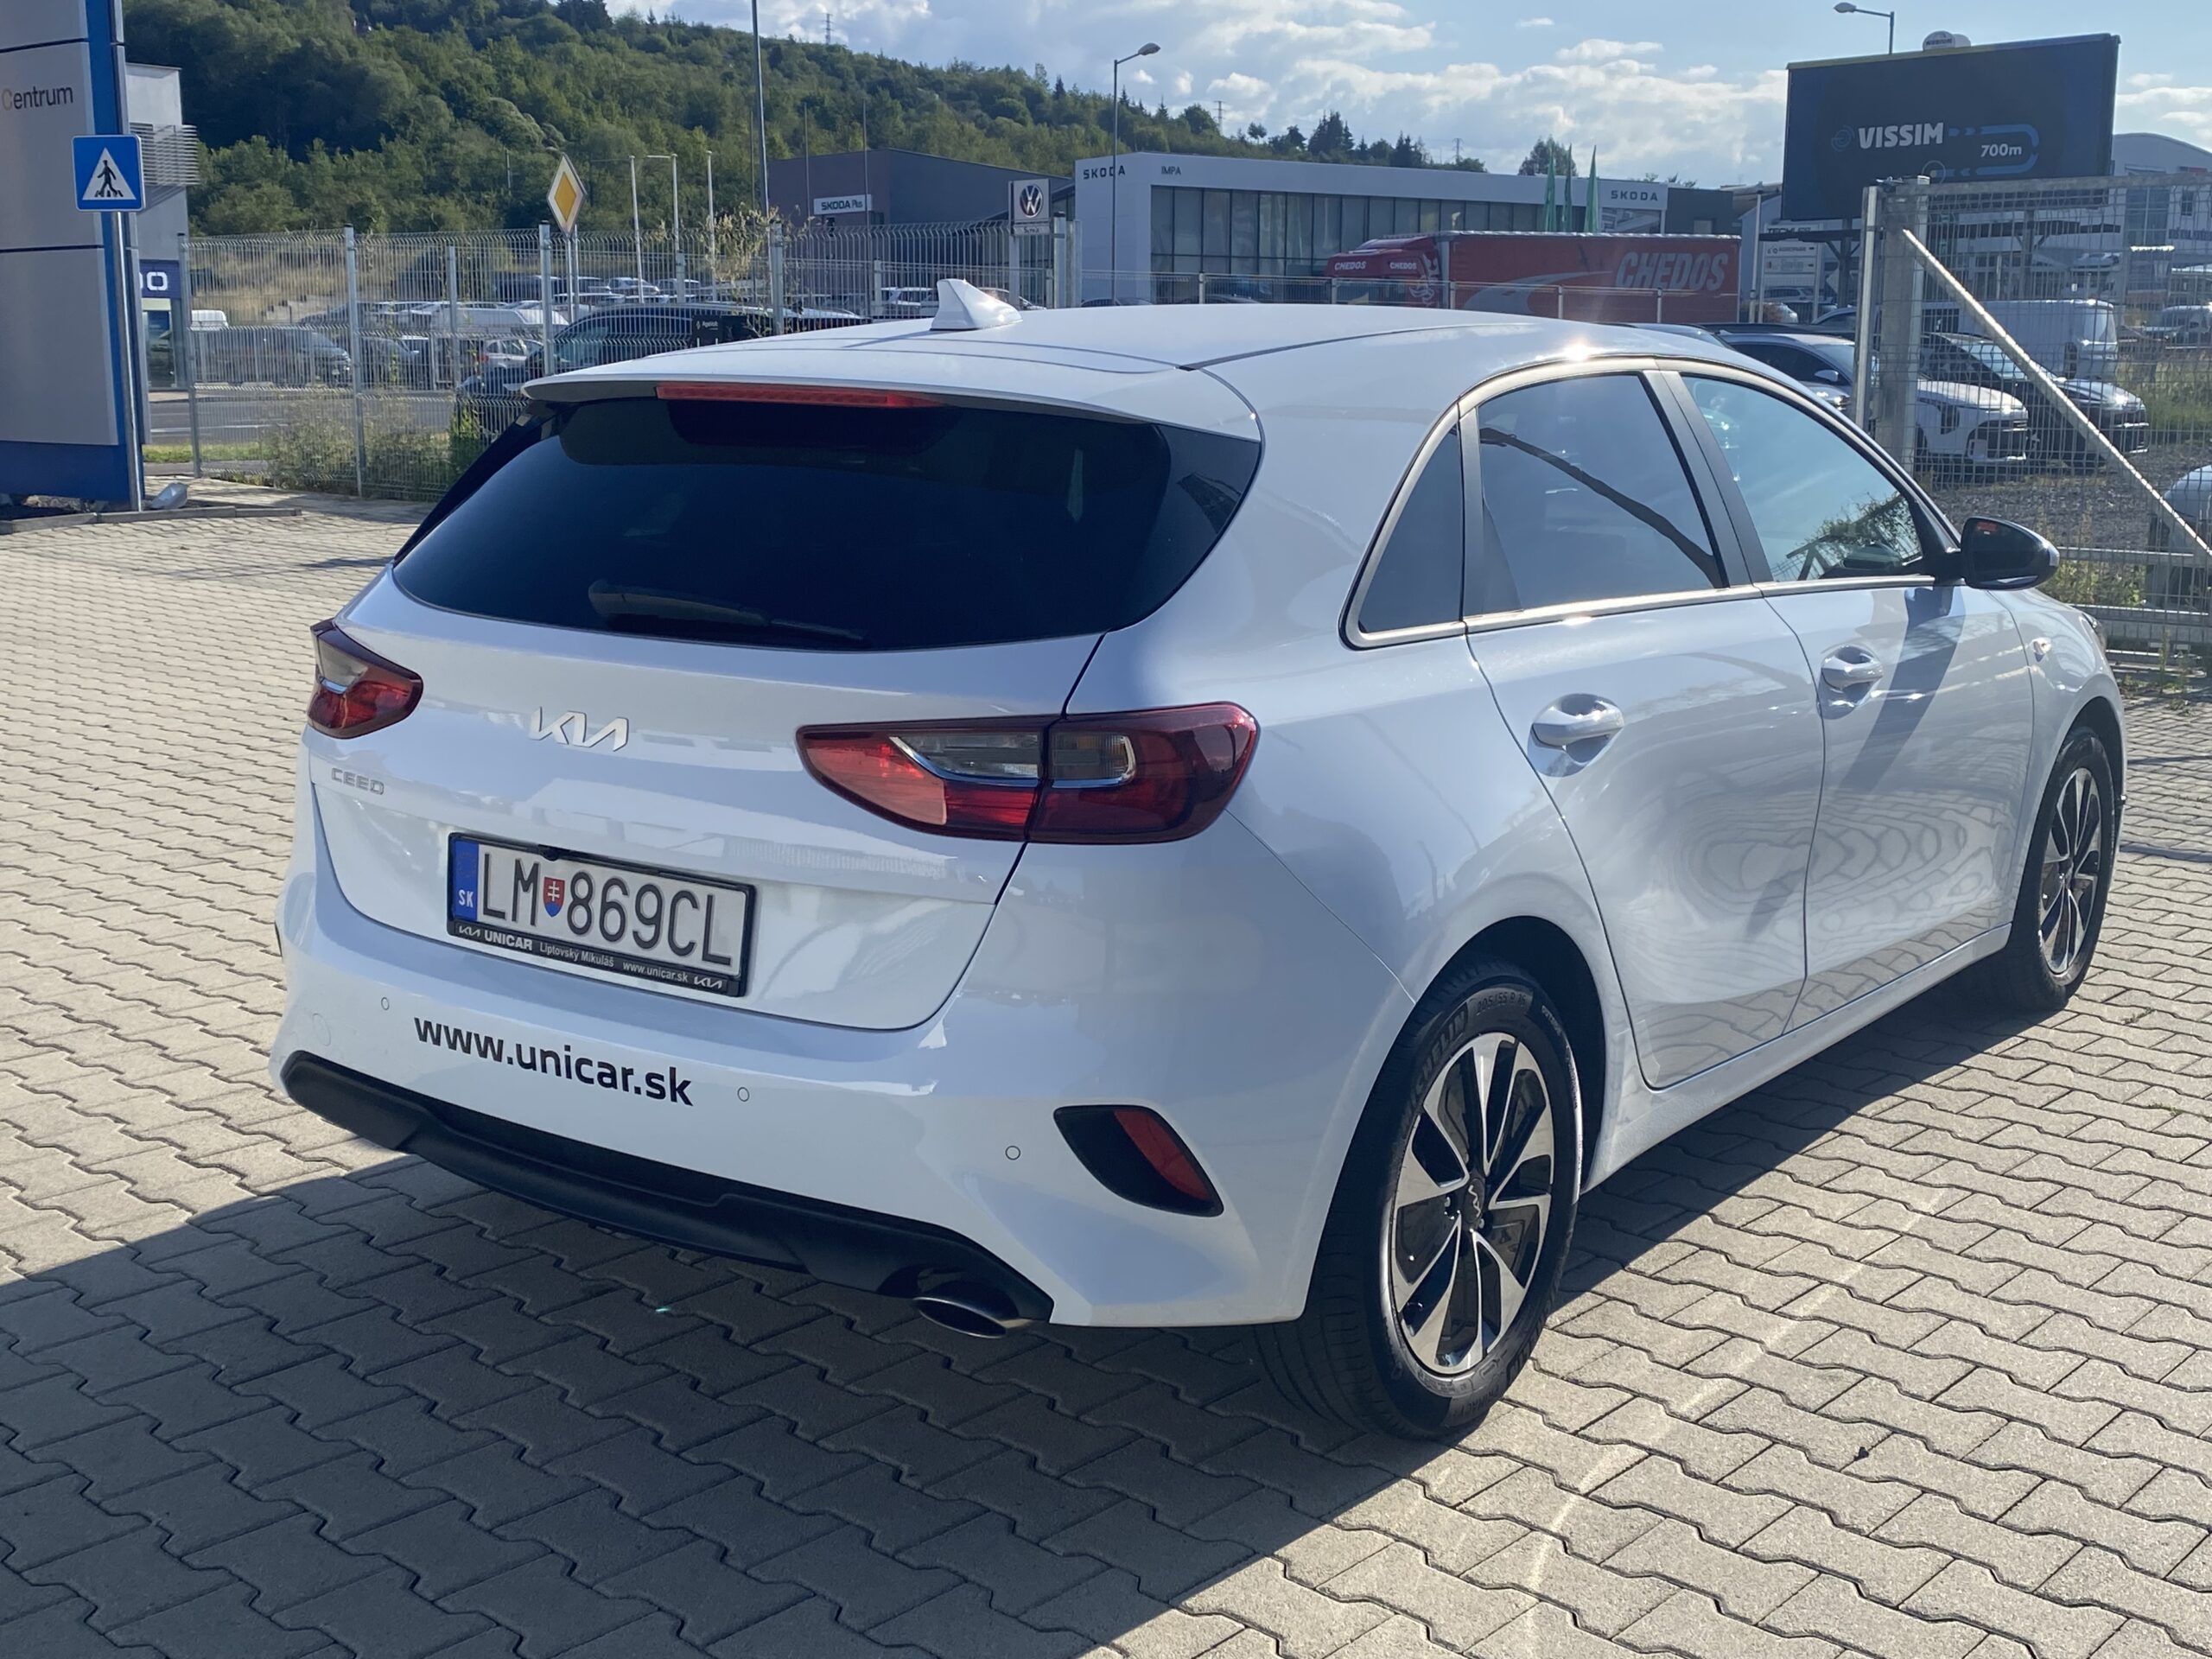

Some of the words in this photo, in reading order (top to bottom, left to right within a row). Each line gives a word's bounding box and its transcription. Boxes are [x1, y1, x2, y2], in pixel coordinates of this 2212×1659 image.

[2, 86, 73, 111] Centrum
[1858, 122, 1944, 149] VISSIM
[1980, 143, 2023, 157] 700m
[1161, 166, 1181, 175] IMPA
[1334, 261, 1367, 270] CHEDOS
[1616, 251, 1729, 291] CHEDOS
[529, 706, 629, 753] KIA
[331, 767, 385, 795] CEED
[458, 889, 474, 908] SK
[484, 930, 533, 951] UNICAR
[539, 942, 581, 962] Liptovský
[581, 951, 614, 968] Mikuláš
[622, 961, 689, 983] www.unicar.sk
[414, 1016, 694, 1107] www.unicar.sk
